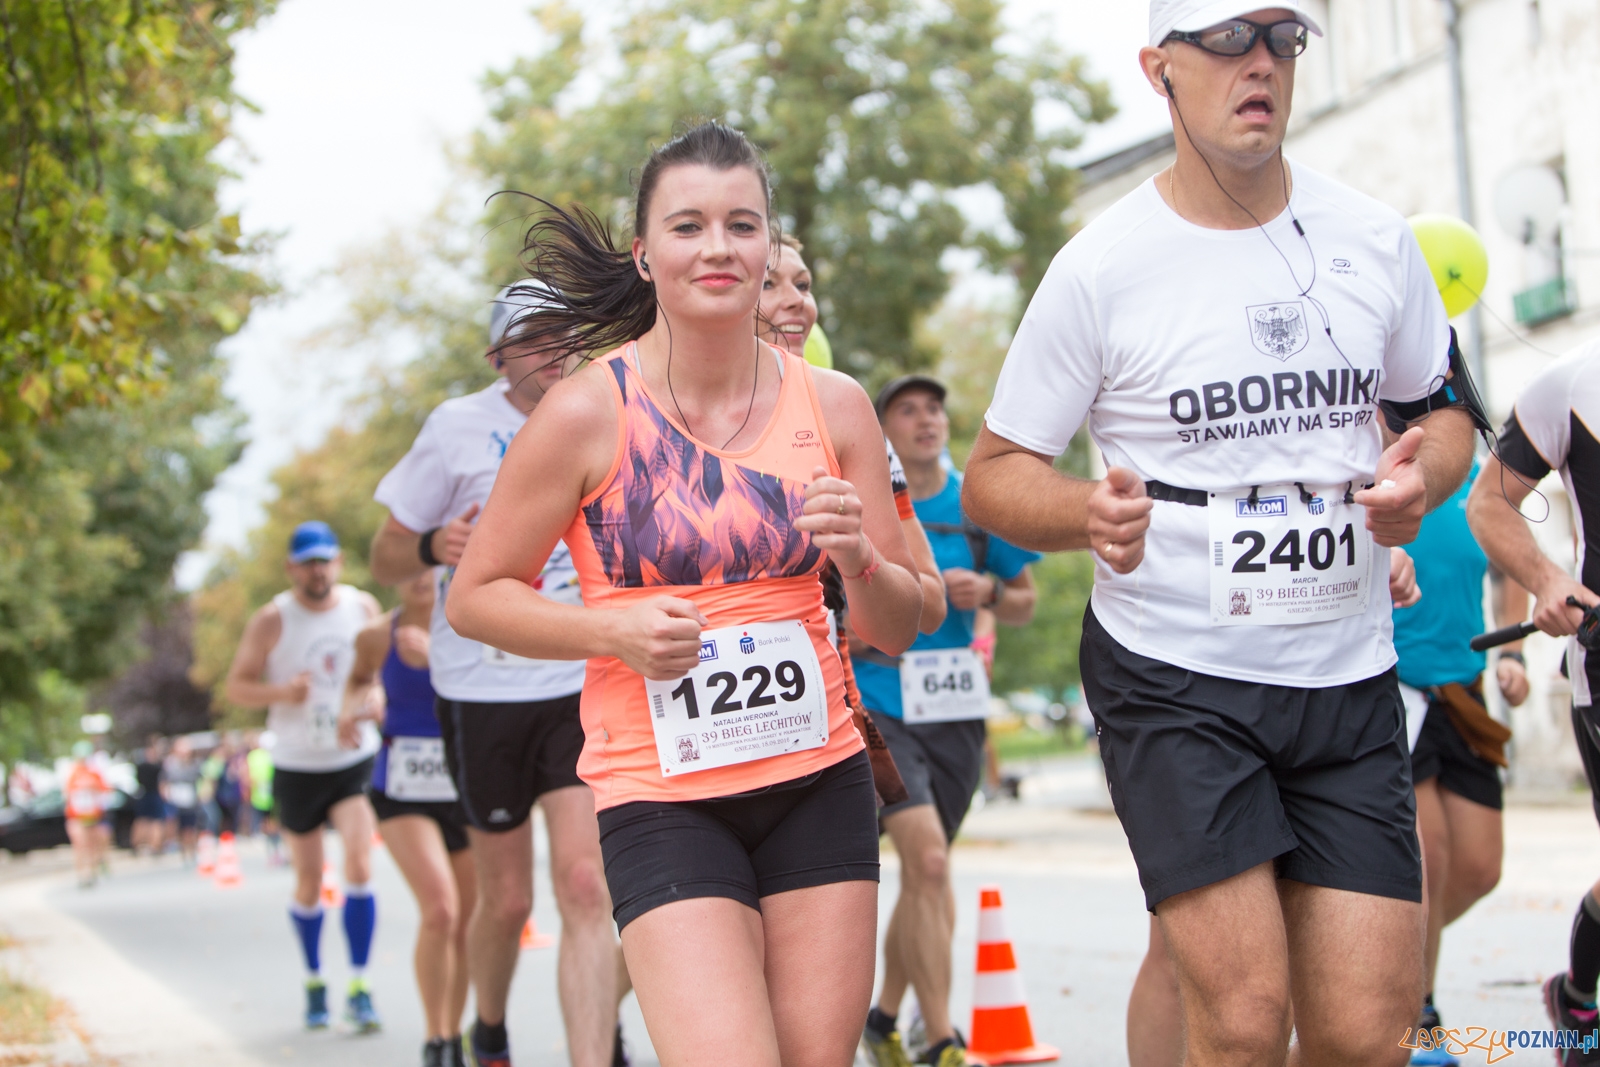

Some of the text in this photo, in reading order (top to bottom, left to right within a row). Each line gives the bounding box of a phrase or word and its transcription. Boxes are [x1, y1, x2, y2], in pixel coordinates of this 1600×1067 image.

[1169, 368, 1380, 426] OBORNIKI
[1177, 409, 1373, 444] STAWIAMY NA SPORT
[1231, 523, 1355, 573] 2401
[1256, 578, 1361, 600] 39 BIEG LECHITÓW
[774, 635, 791, 644] Polski
[671, 660, 806, 720] 1229
[923, 671, 973, 694] 648
[701, 711, 812, 743] 39 BIEG LECHITÓW
[713, 710, 779, 728] NATALIA WERONIKA
